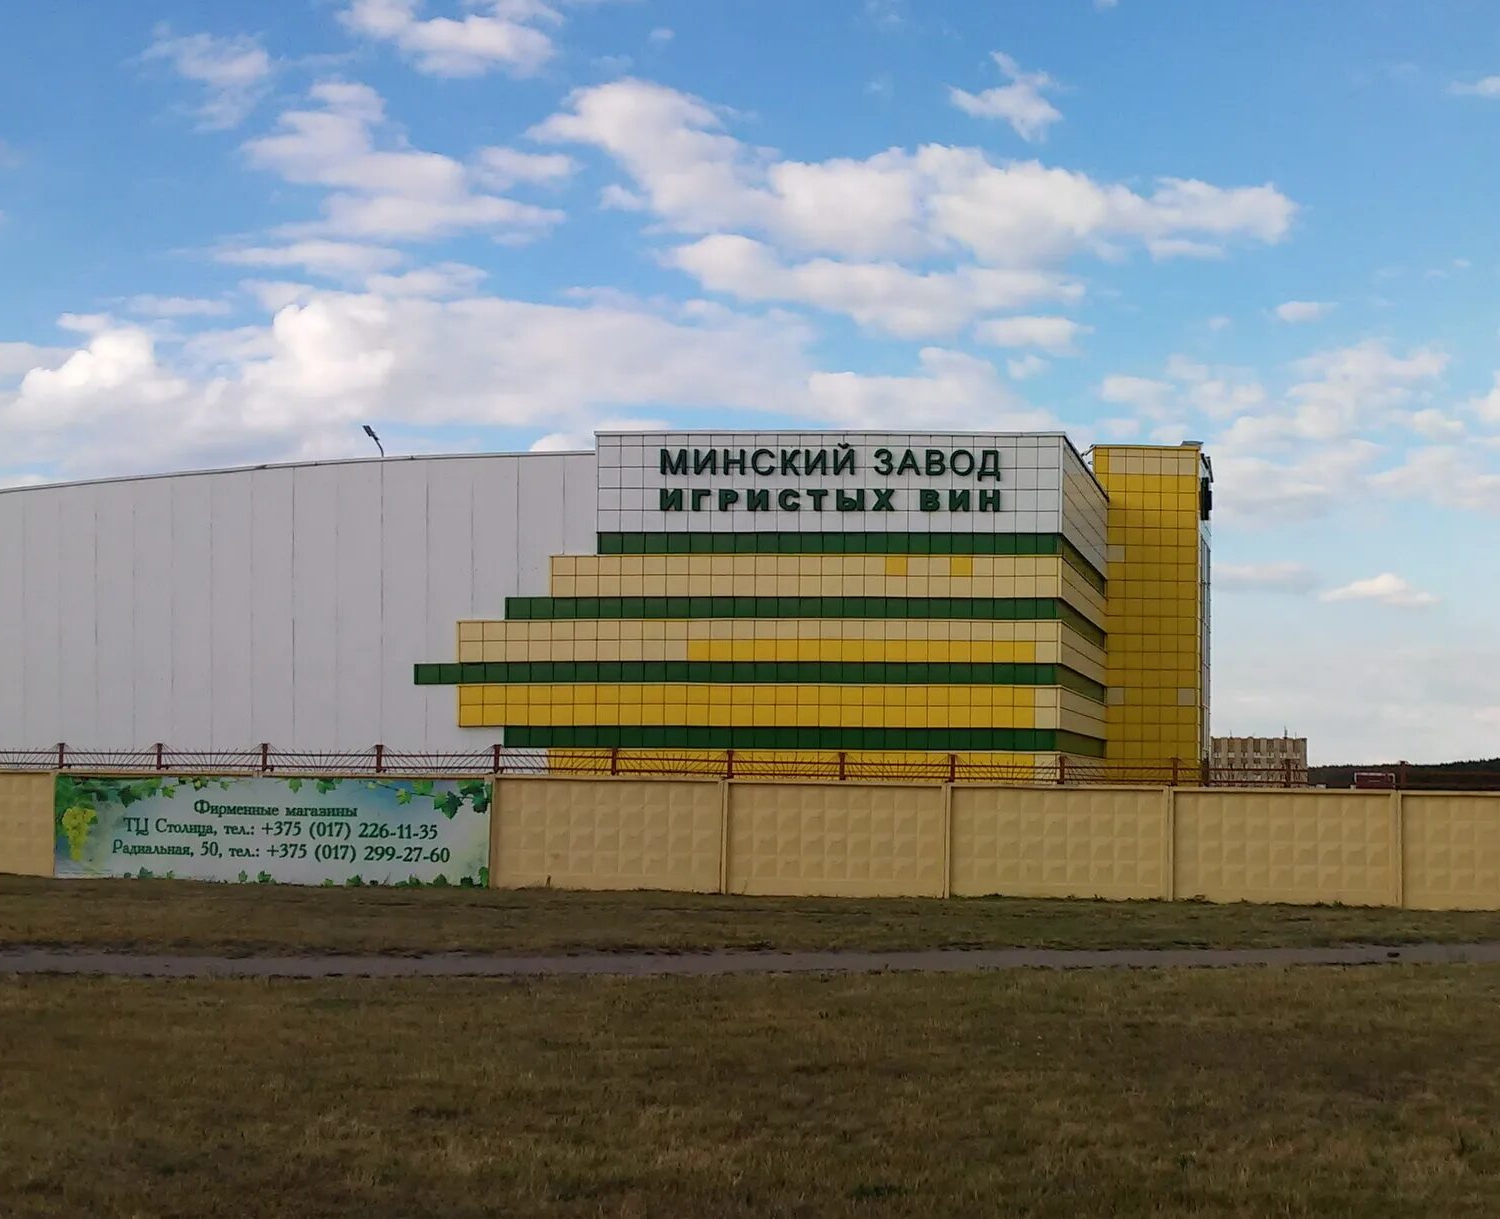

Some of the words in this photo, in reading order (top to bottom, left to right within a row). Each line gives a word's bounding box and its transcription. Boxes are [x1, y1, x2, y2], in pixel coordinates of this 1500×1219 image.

[660, 443, 856, 476] МИНСКИЙ
[873, 448, 1002, 482] ЗАВОД
[659, 488, 895, 512] ИГРИСТЫХ
[919, 488, 1001, 513] ВИН
[194, 800, 279, 818] Фирменные
[285, 807, 358, 818] магазины
[123, 817, 150, 836] ТЦ
[155, 818, 218, 837] Столица,
[223, 824, 255, 836] тел.:
[261, 821, 302, 837] +375
[309, 821, 352, 840] (017)
[357, 822, 438, 840] 226-11-35
[112, 839, 194, 858] Радиальная,
[200, 841, 223, 858] 50,
[228, 846, 260, 858] тел.:
[266, 843, 308, 860] +375
[314, 843, 357, 863] (017)
[363, 845, 451, 863] 299-27-60
